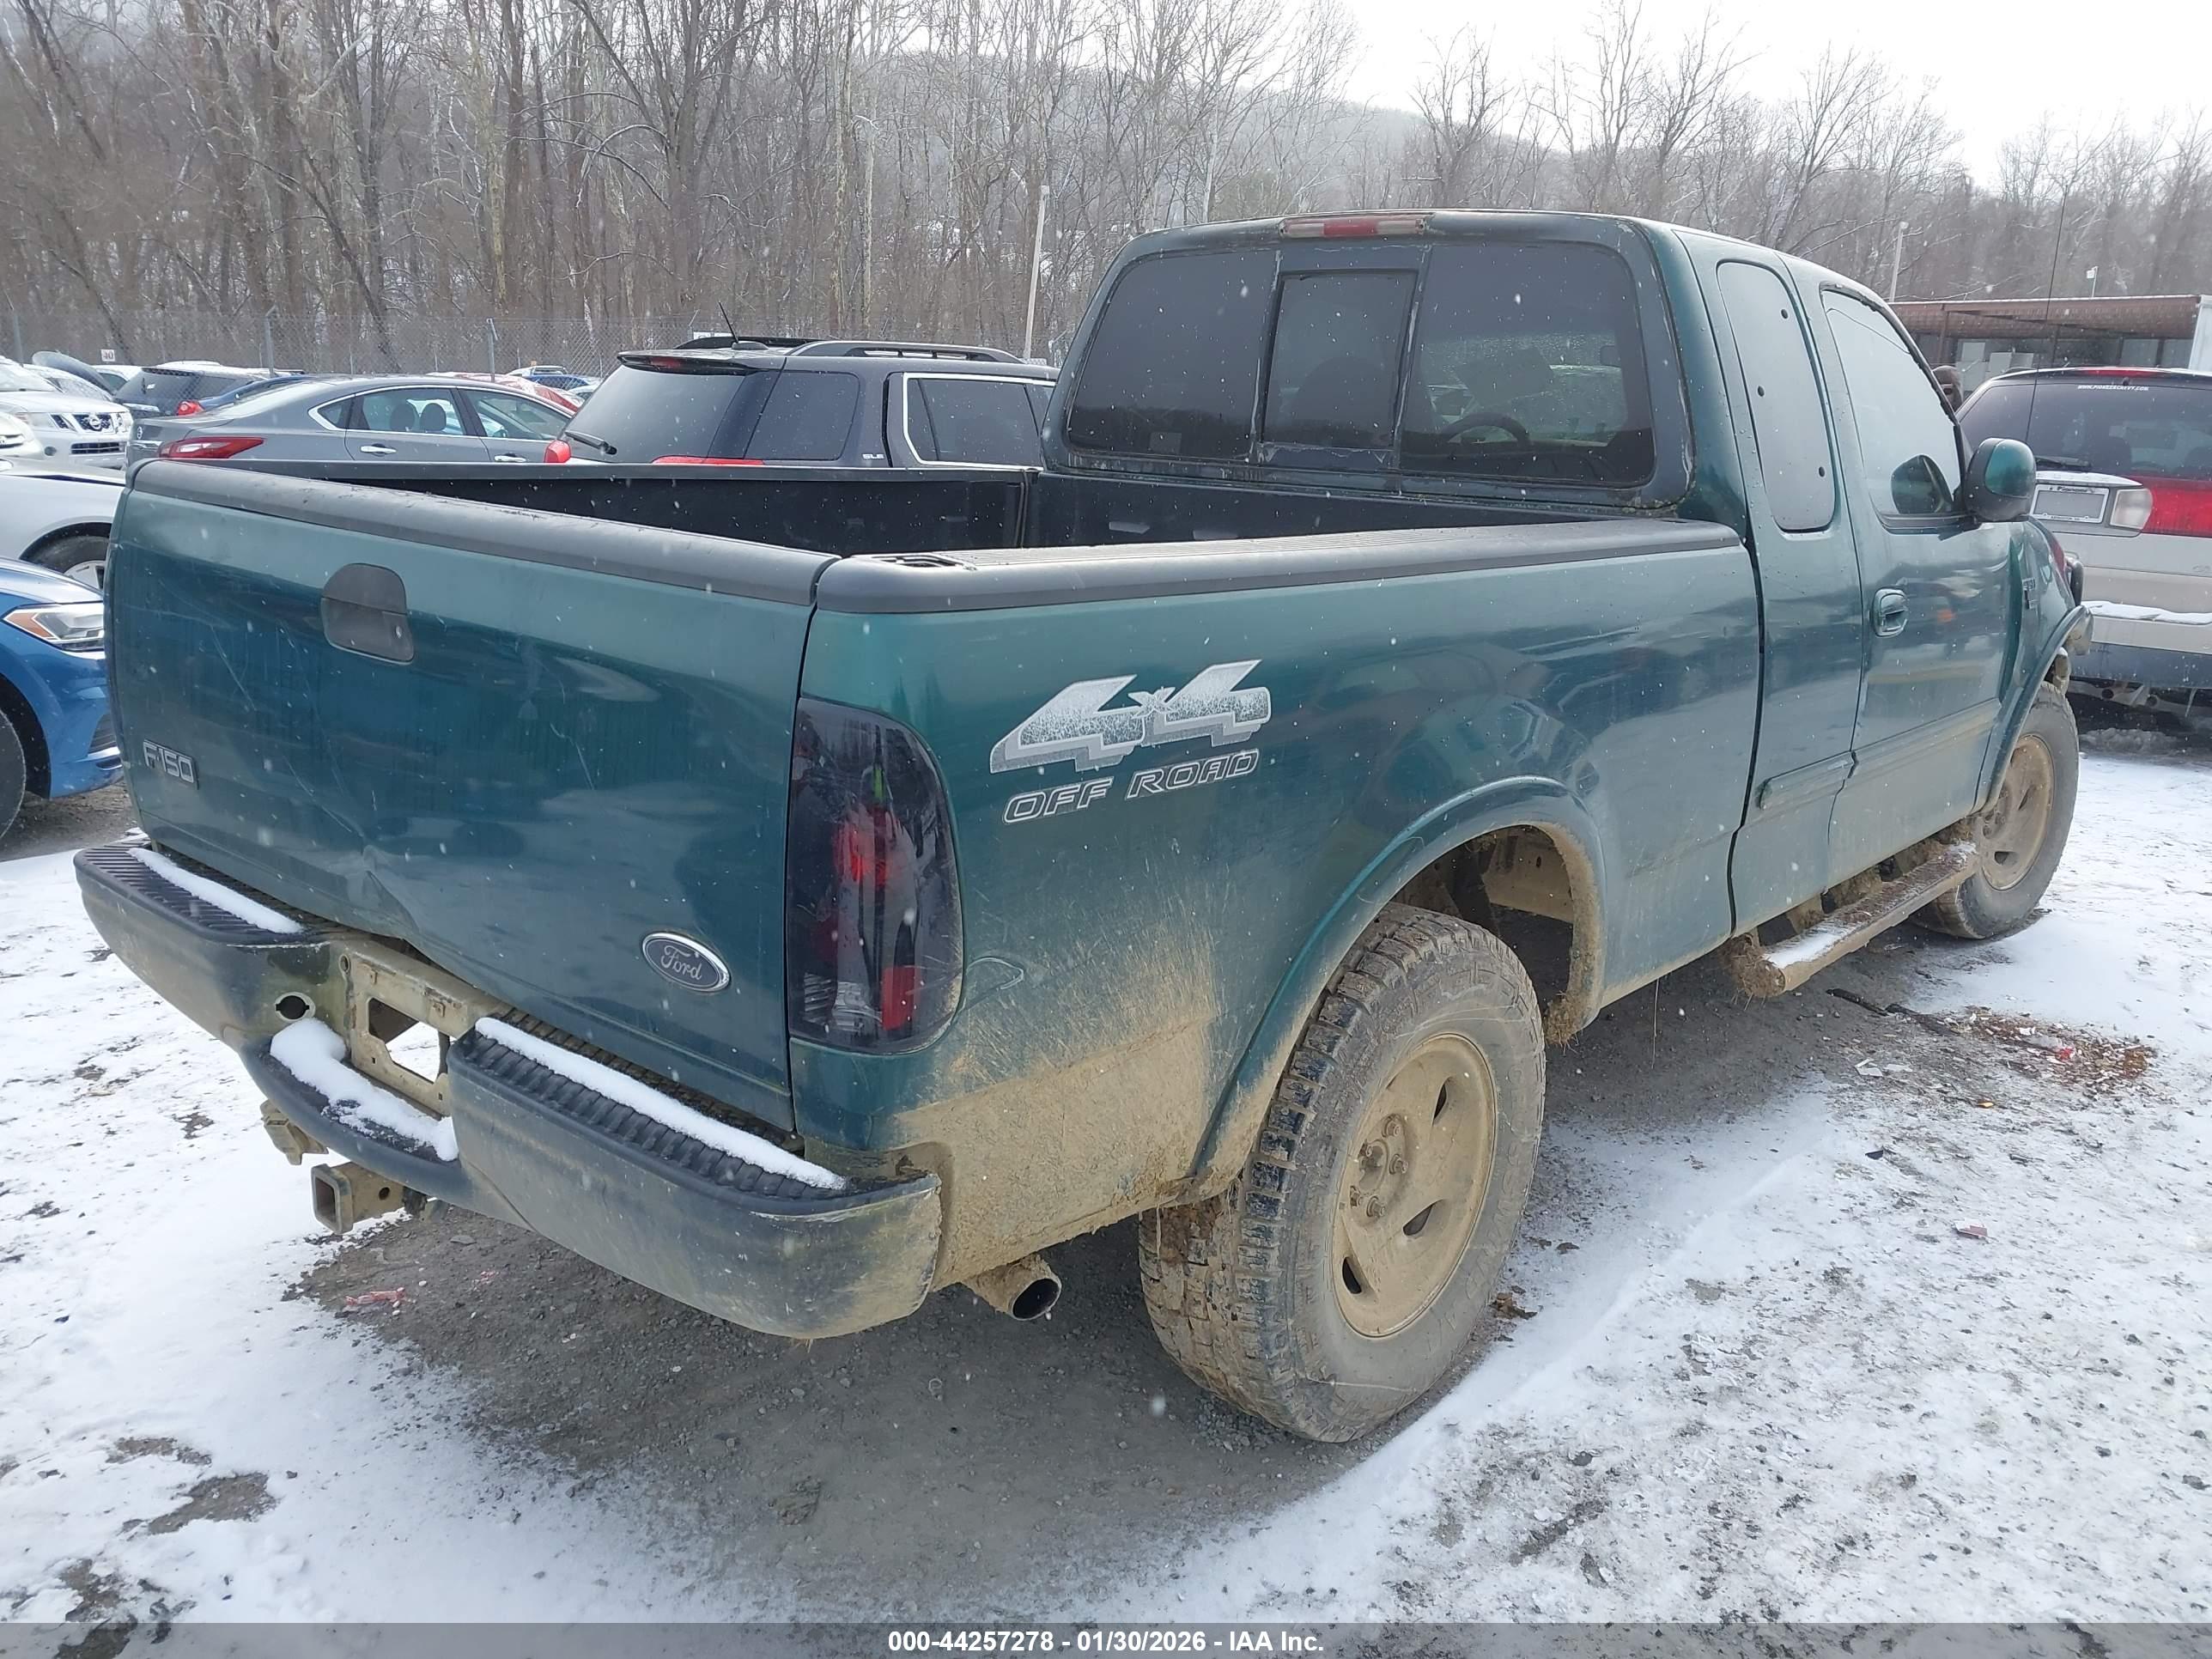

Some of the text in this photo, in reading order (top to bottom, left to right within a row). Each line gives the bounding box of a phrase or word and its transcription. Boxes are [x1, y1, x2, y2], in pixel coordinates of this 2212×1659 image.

[1002, 749, 1261, 823] OFF ROAD
[660, 945, 702, 980] Ford
